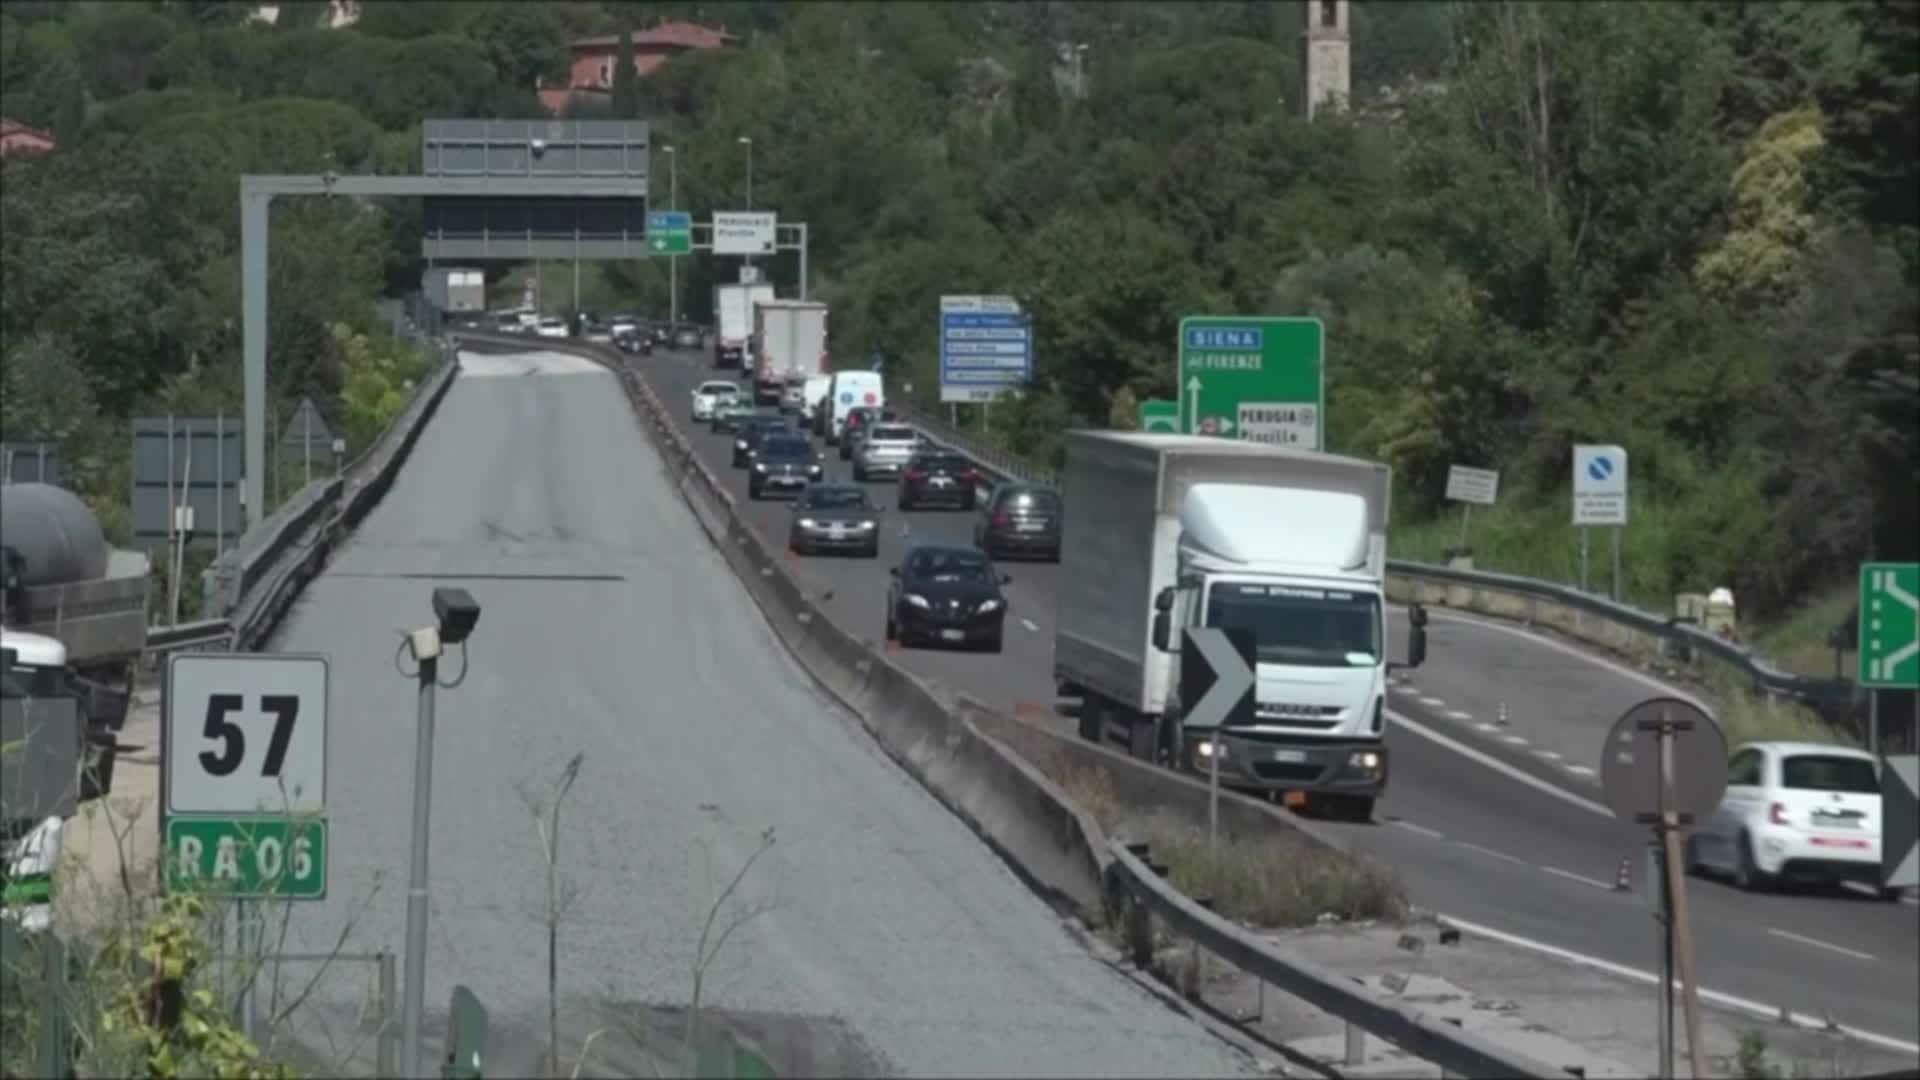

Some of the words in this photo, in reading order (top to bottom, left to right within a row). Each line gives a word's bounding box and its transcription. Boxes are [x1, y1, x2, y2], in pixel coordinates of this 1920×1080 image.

[1194, 331, 1254, 346] SIENA
[1206, 354, 1263, 370] FIRENZE
[1240, 409, 1296, 424] PERUGIA
[198, 693, 300, 778] 57
